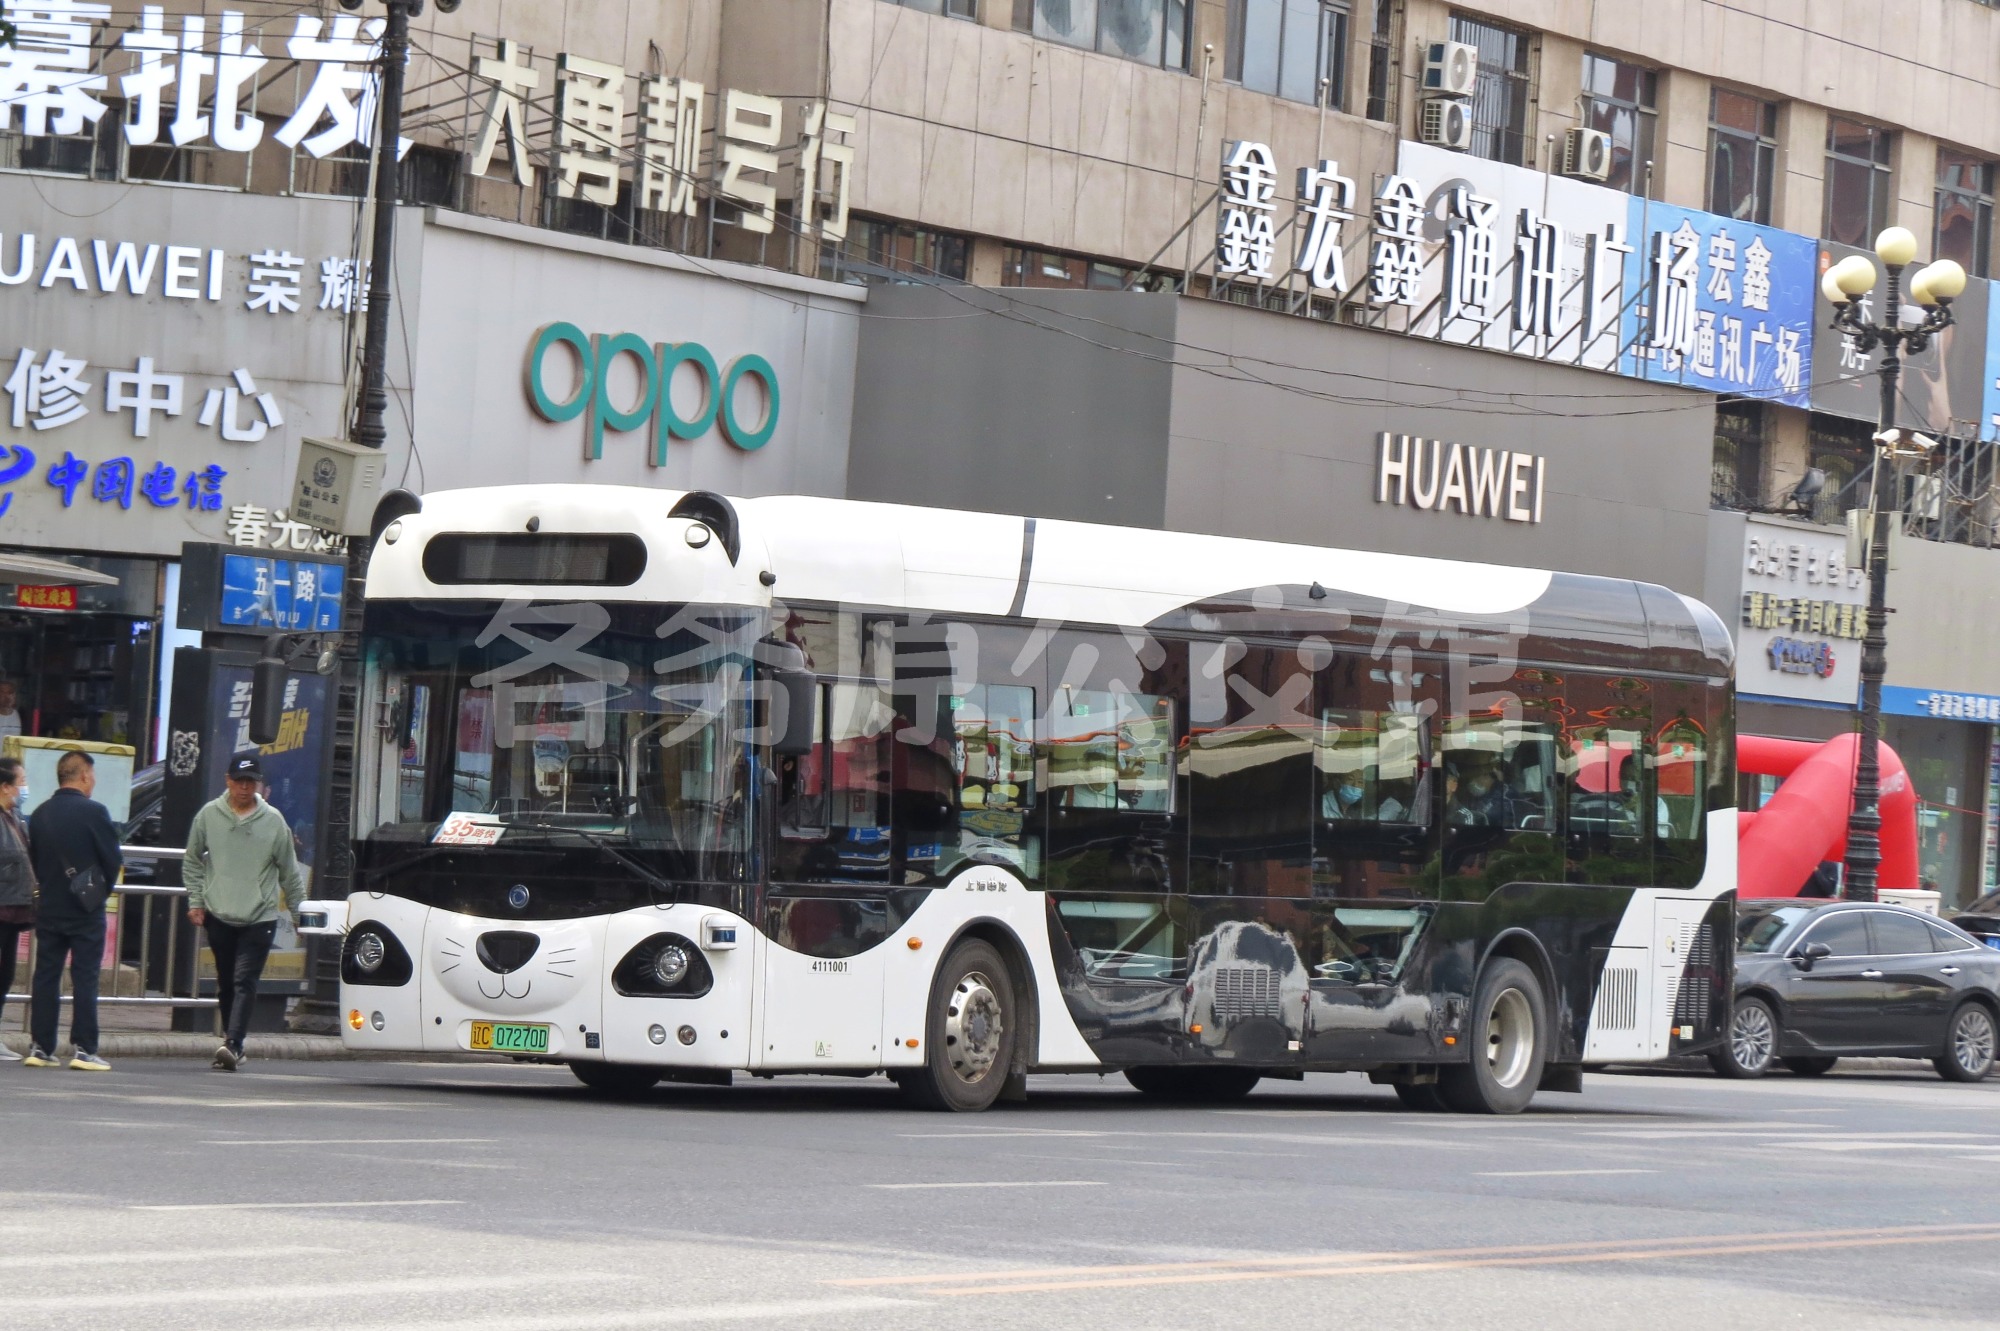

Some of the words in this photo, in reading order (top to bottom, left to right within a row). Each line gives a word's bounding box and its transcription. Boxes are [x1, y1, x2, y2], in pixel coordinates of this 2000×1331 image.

[470, 39, 857, 241] 大勇靓号行
[1217, 141, 1697, 355] 鑫宏鑫通讯广场
[4, 347, 284, 442] 修中心
[47, 451, 228, 512] 中国电信
[1377, 432, 1546, 524] HUAWEI
[252, 568, 314, 602] 五一路
[811, 961, 849, 973] 4111001
